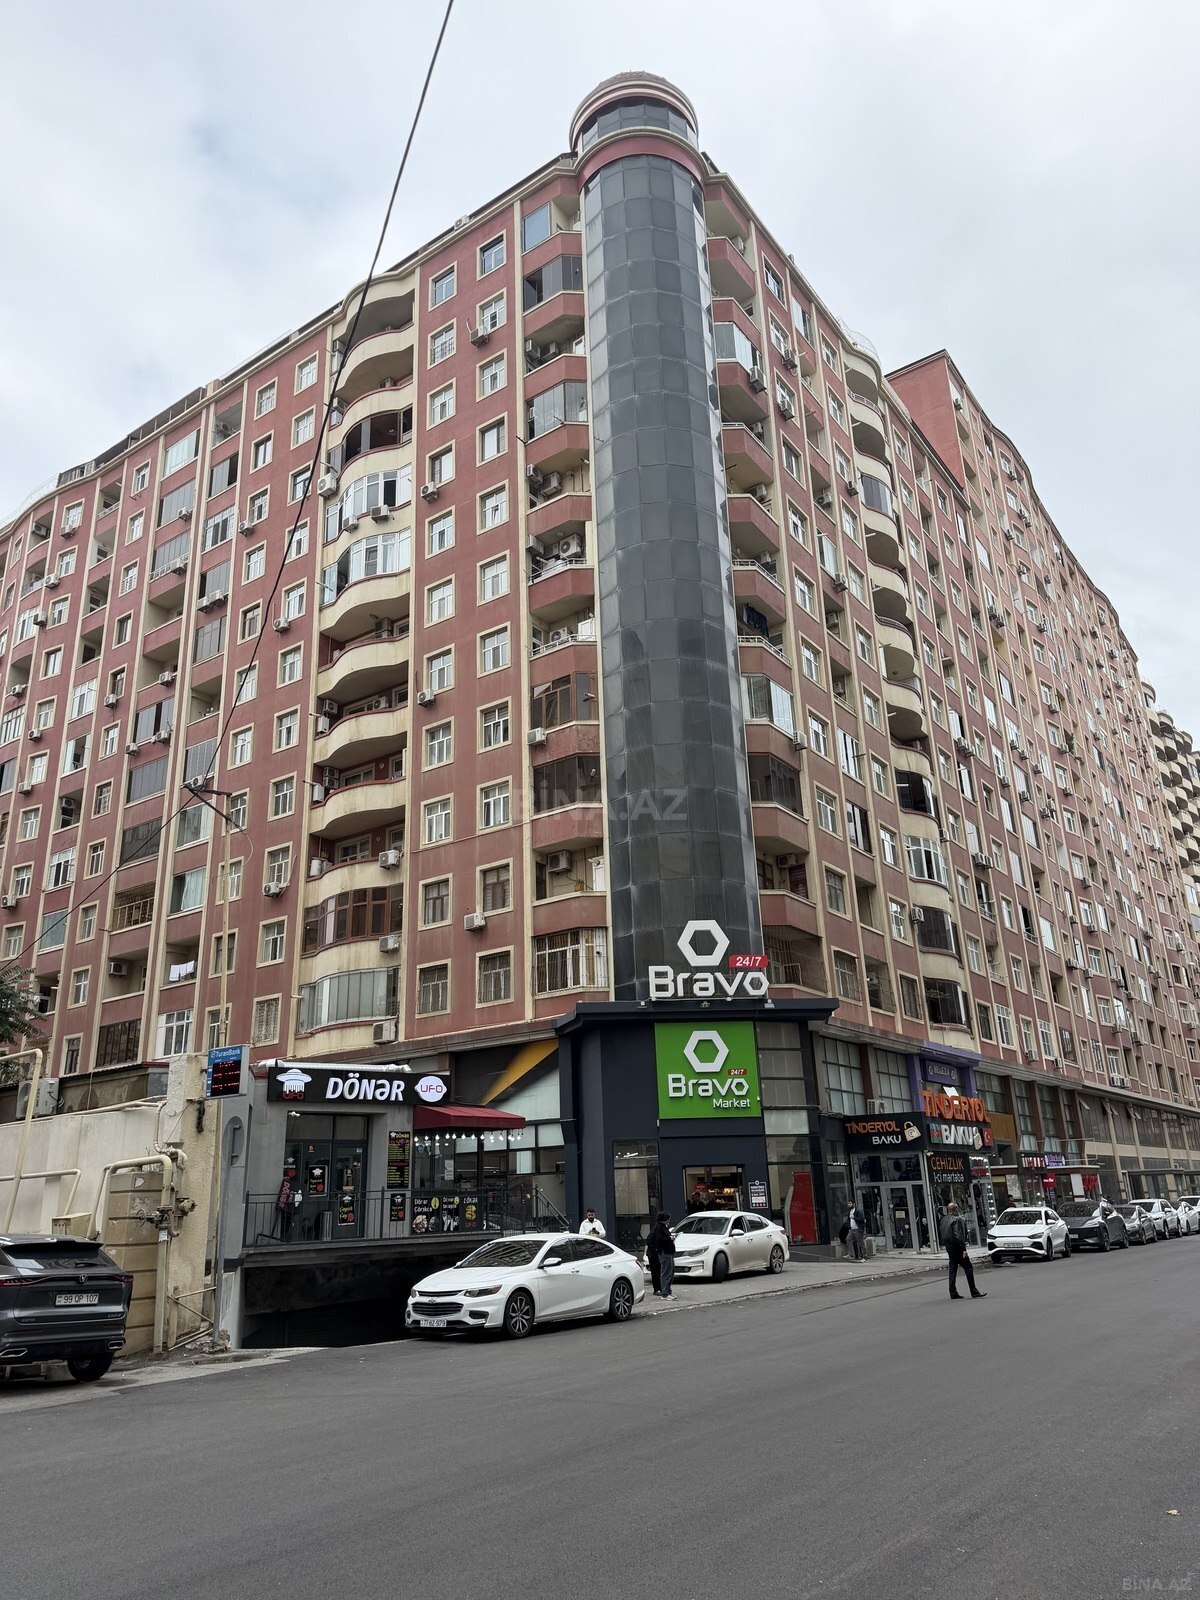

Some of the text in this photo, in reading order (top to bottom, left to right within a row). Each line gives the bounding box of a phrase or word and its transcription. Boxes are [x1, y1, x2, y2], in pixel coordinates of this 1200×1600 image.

[735, 956, 762, 967] 24/7
[648, 965, 770, 998] Bravo
[215, 1048, 241, 1058] TuranBank
[420, 1084, 443, 1093] UFO
[668, 1074, 749, 1097] Bravo
[282, 1091, 304, 1100] UFO
[712, 1098, 750, 1108] Market
[920, 1089, 992, 1123] TİNDERYOL
[845, 1121, 900, 1134] TİNDERYOL
[941, 1124, 973, 1145] BAKU
[872, 1135, 901, 1145] BAKU
[63, 1295, 73, 1304] 99
[86, 1294, 97, 1303] 107
